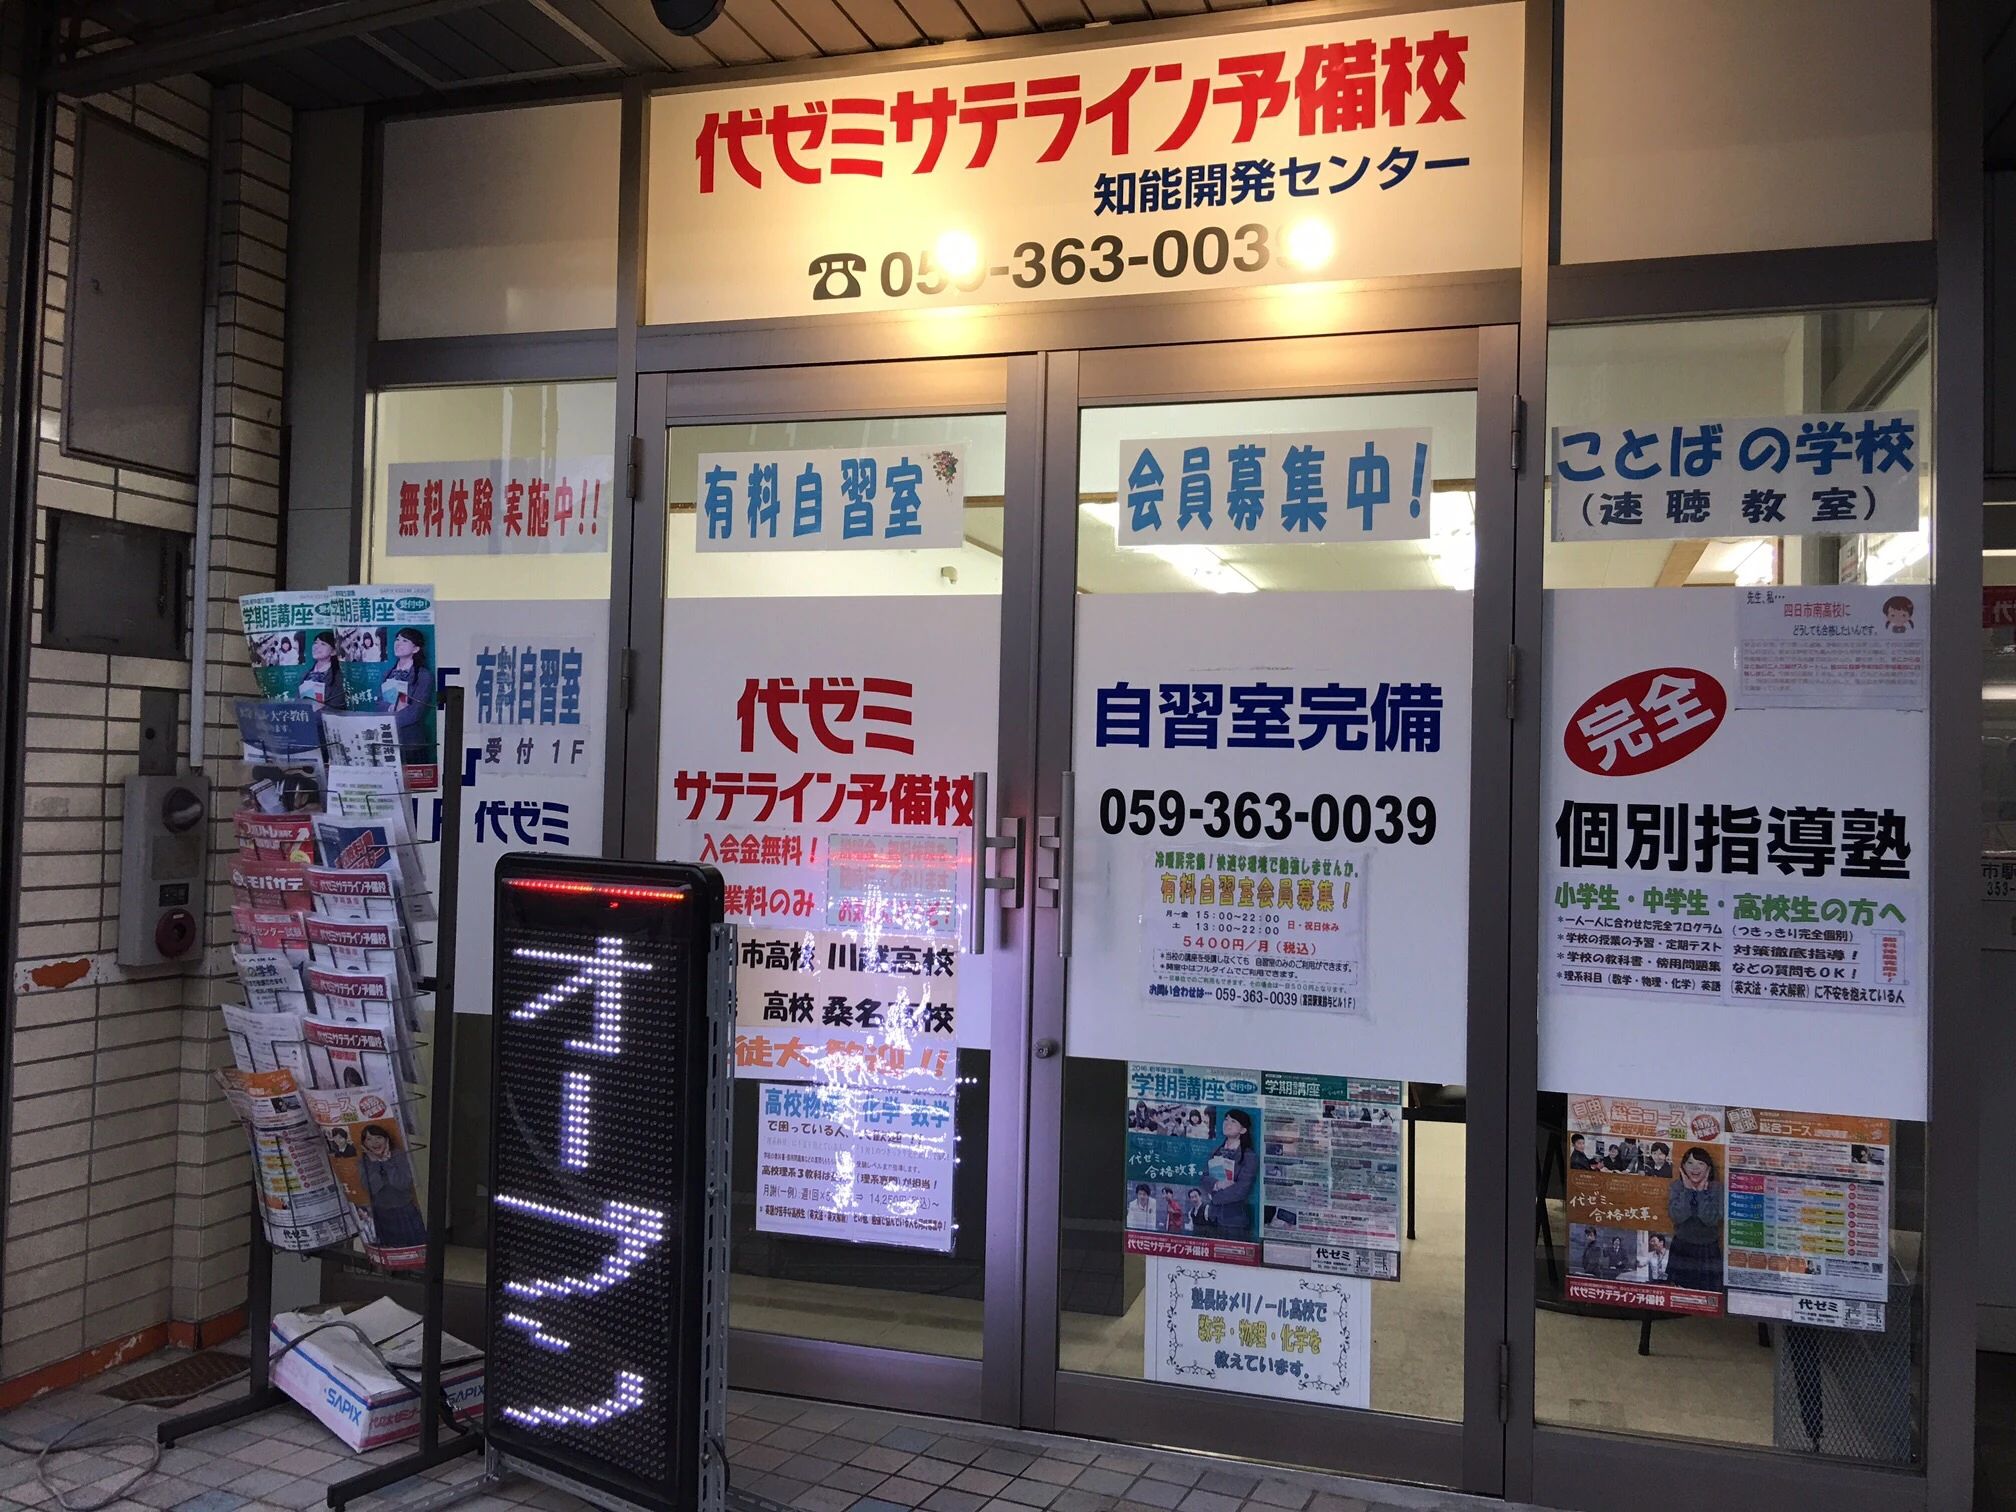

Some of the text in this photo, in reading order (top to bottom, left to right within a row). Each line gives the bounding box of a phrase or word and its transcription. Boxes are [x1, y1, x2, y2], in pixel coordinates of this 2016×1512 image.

[695, 30, 1470, 194] 代ゼミサテライン予備校
[1093, 147, 1471, 217] 知能開発センター
[880, 223, 1312, 297] 05-363-003
[1557, 418, 1915, 482] ことばの学校
[398, 478, 494, 538] 無料体験
[704, 457, 924, 540] 有料自習室
[1128, 441, 1428, 532] 会員募集中!
[1582, 486, 1876, 527] (速聴教室)
[1783, 602, 1851, 618] 四日市南高校に
[1792, 624, 1878, 636] どうしても合格したいんです。
[475, 645, 583, 726] 有料自習室
[736, 677, 914, 755] 代ゼミ
[1096, 681, 1443, 753] 自習室完備
[1576, 674, 1716, 771] 完全
[674, 770, 974, 826] サテライン予備校
[1099, 788, 1437, 846] 059-363-0039
[474, 800, 570, 846] 代ゼミ
[1555, 799, 1911, 880] 個別指導塾
[700, 833, 818, 866] 入会金無料!
[1160, 872, 1350, 912] 有料自習室会員募集!
[1555, 881, 1907, 926] 小学生・中学生・高校生の方へ
[1287, 920, 1340, 932] 日・祝日休み
[736, 938, 816, 972] 市高校
[1215, 987, 1298, 1006] 059-363-0039
[1131, 1072, 1225, 1102] 学期講座
[1265, 1079, 1320, 1097] 学期講座
[1316, 1246, 1350, 1261] 代ゼミ
[1191, 1286, 1328, 1323] 塾長はメリノール高校で
[1798, 1298, 1838, 1312] 代ゼミ
[1214, 1350, 1310, 1379] 教えています。
[326, 1387, 362, 1427] SAPIX
